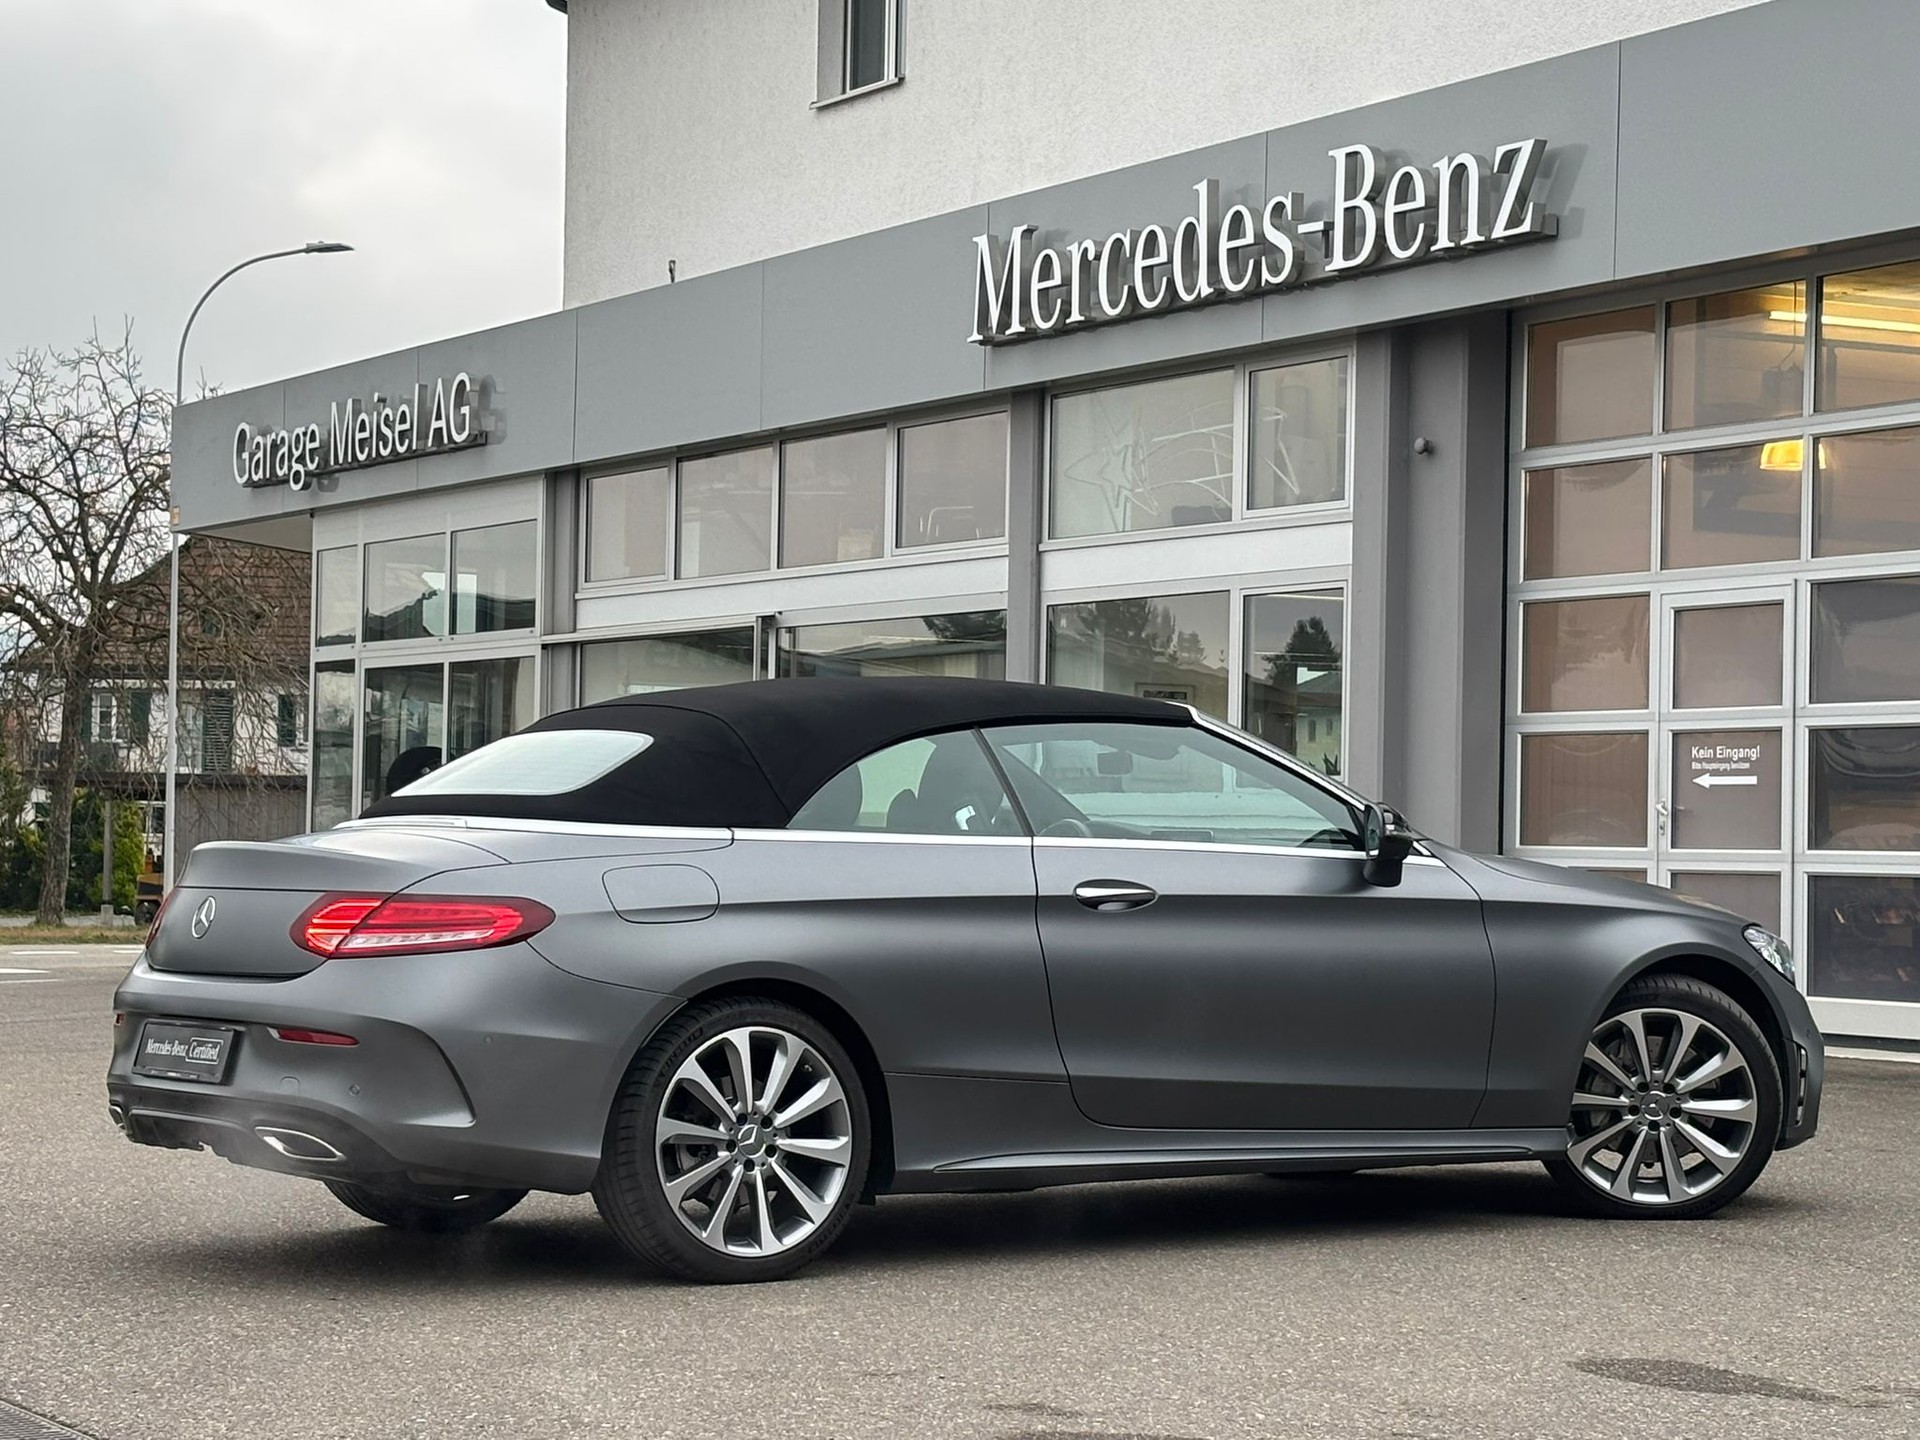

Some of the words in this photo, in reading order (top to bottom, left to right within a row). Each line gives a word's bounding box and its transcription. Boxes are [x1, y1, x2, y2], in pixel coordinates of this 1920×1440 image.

[966, 138, 1547, 344] Mercedes-Benz
[233, 422, 320, 491] Garage
[329, 383, 419, 466] Meisel
[428, 372, 471, 447] AG
[1691, 746, 1714, 758] Kein
[1716, 745, 1761, 761] Eingang!
[189, 1041, 221, 1060] Certified
